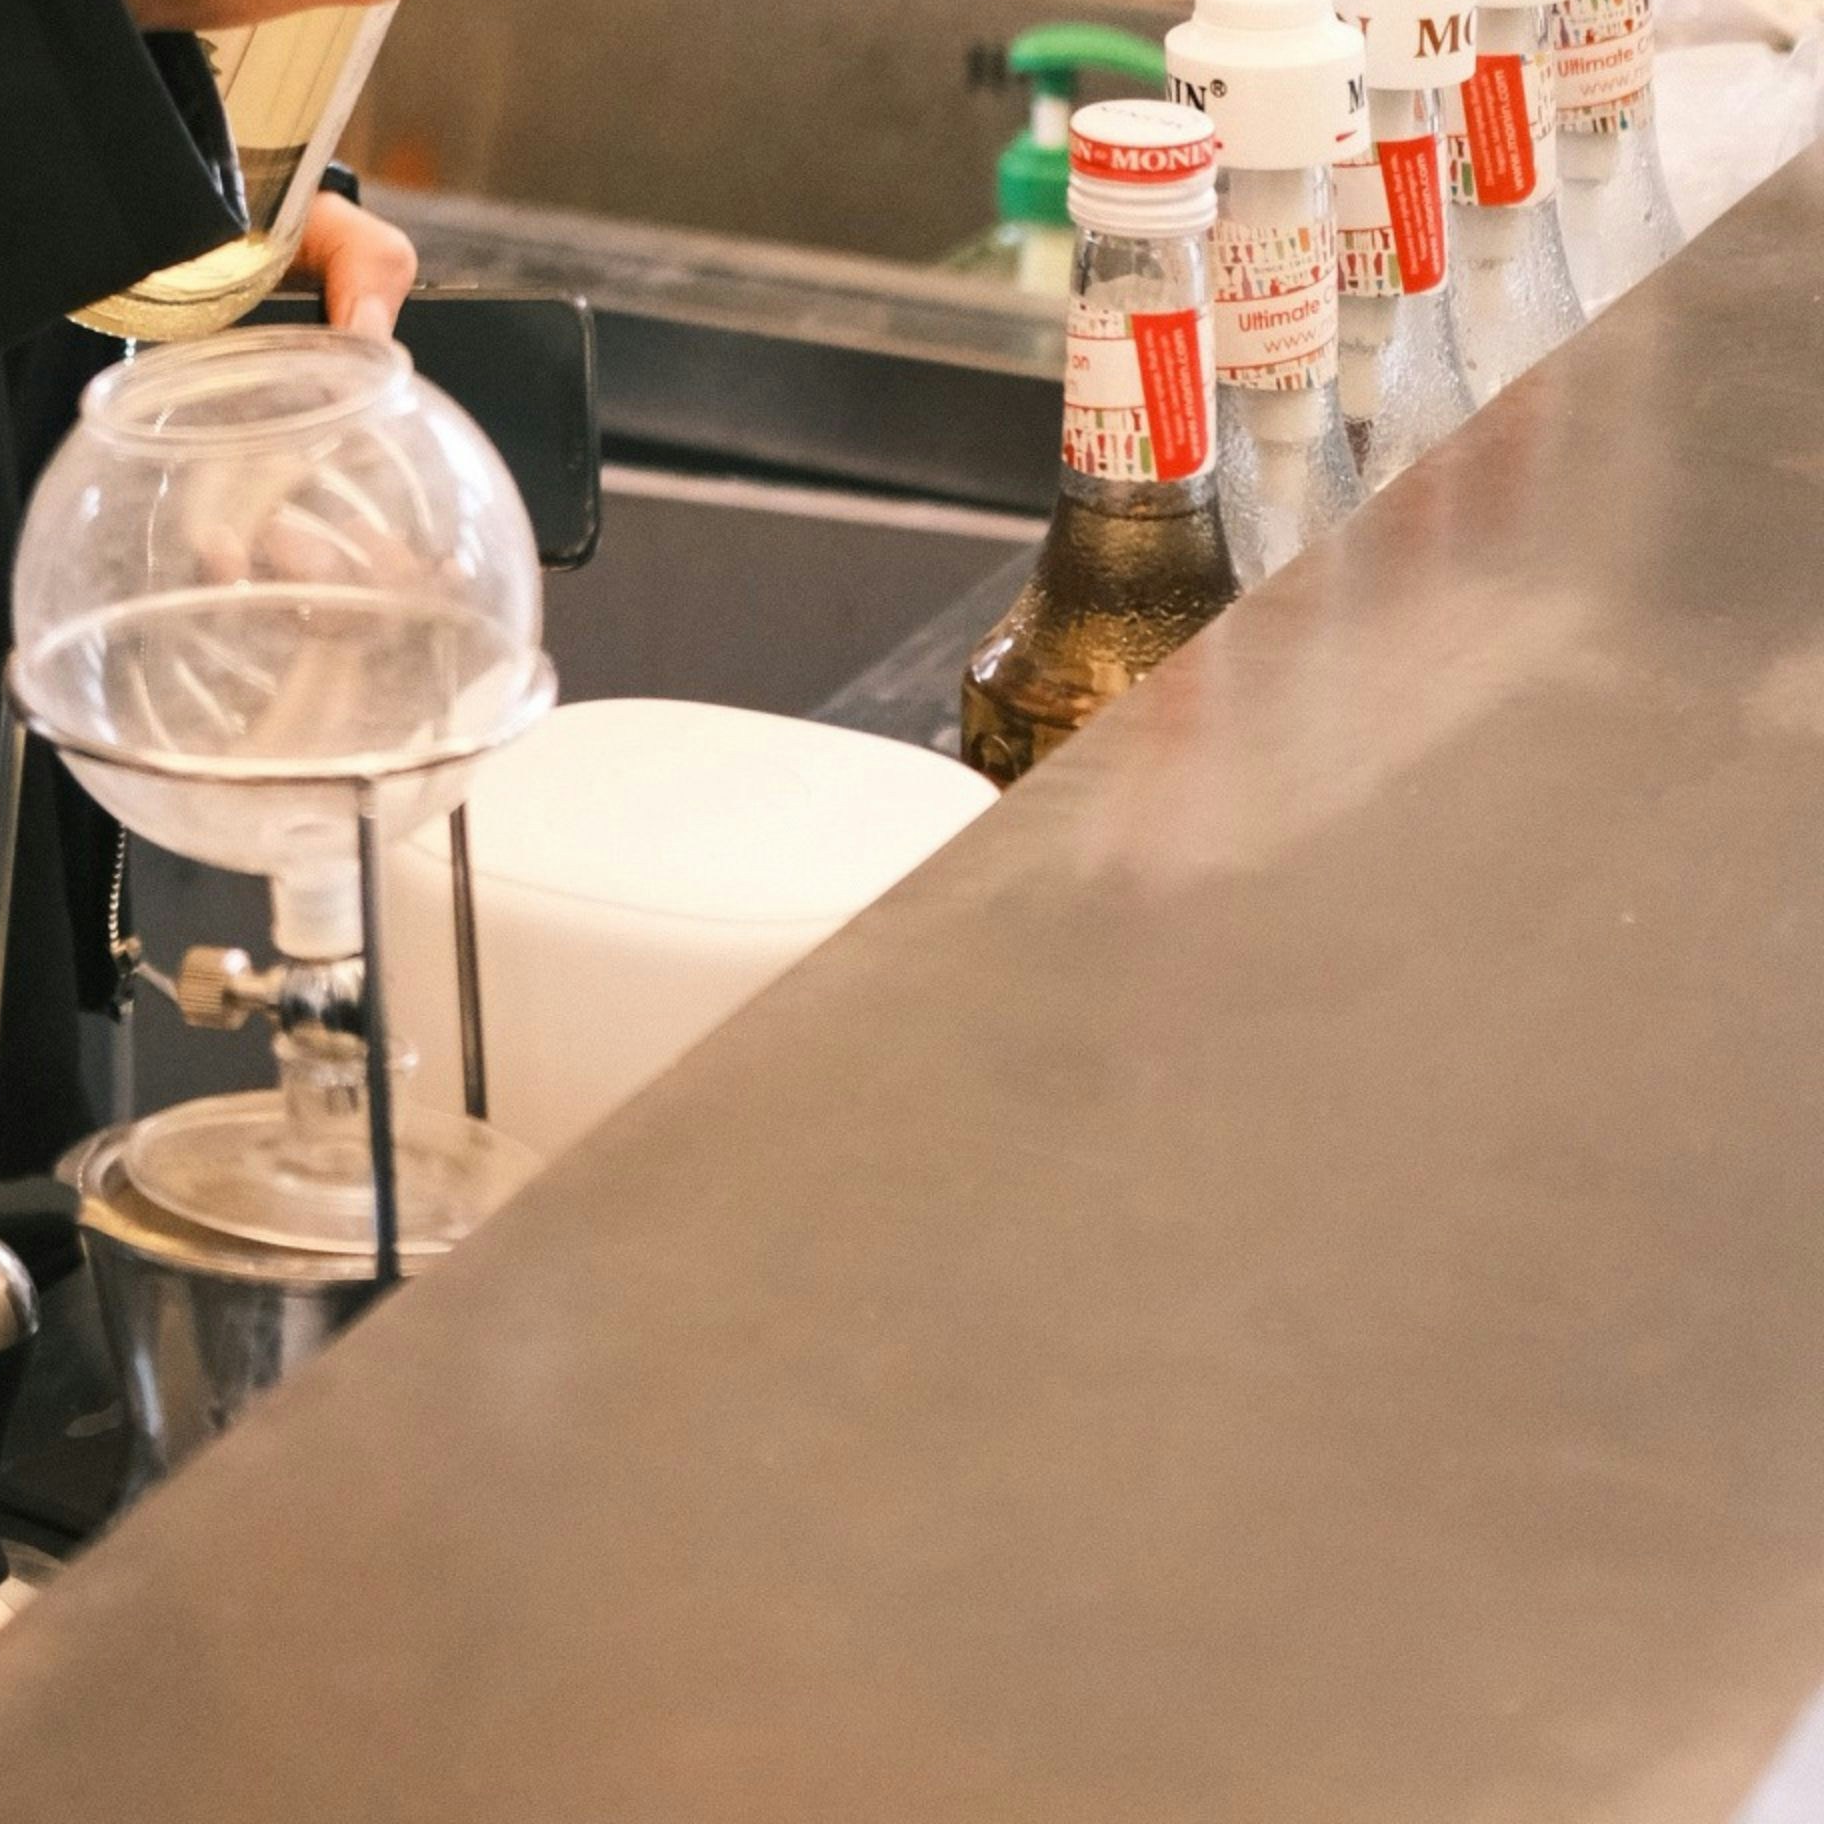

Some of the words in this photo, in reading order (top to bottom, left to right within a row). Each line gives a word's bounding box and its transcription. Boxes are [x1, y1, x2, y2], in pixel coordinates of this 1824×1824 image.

[1557, 48, 1633, 78] Ultimate
[1110, 137, 1214, 172] MONIN
[1237, 299, 1321, 333] Ultimate
